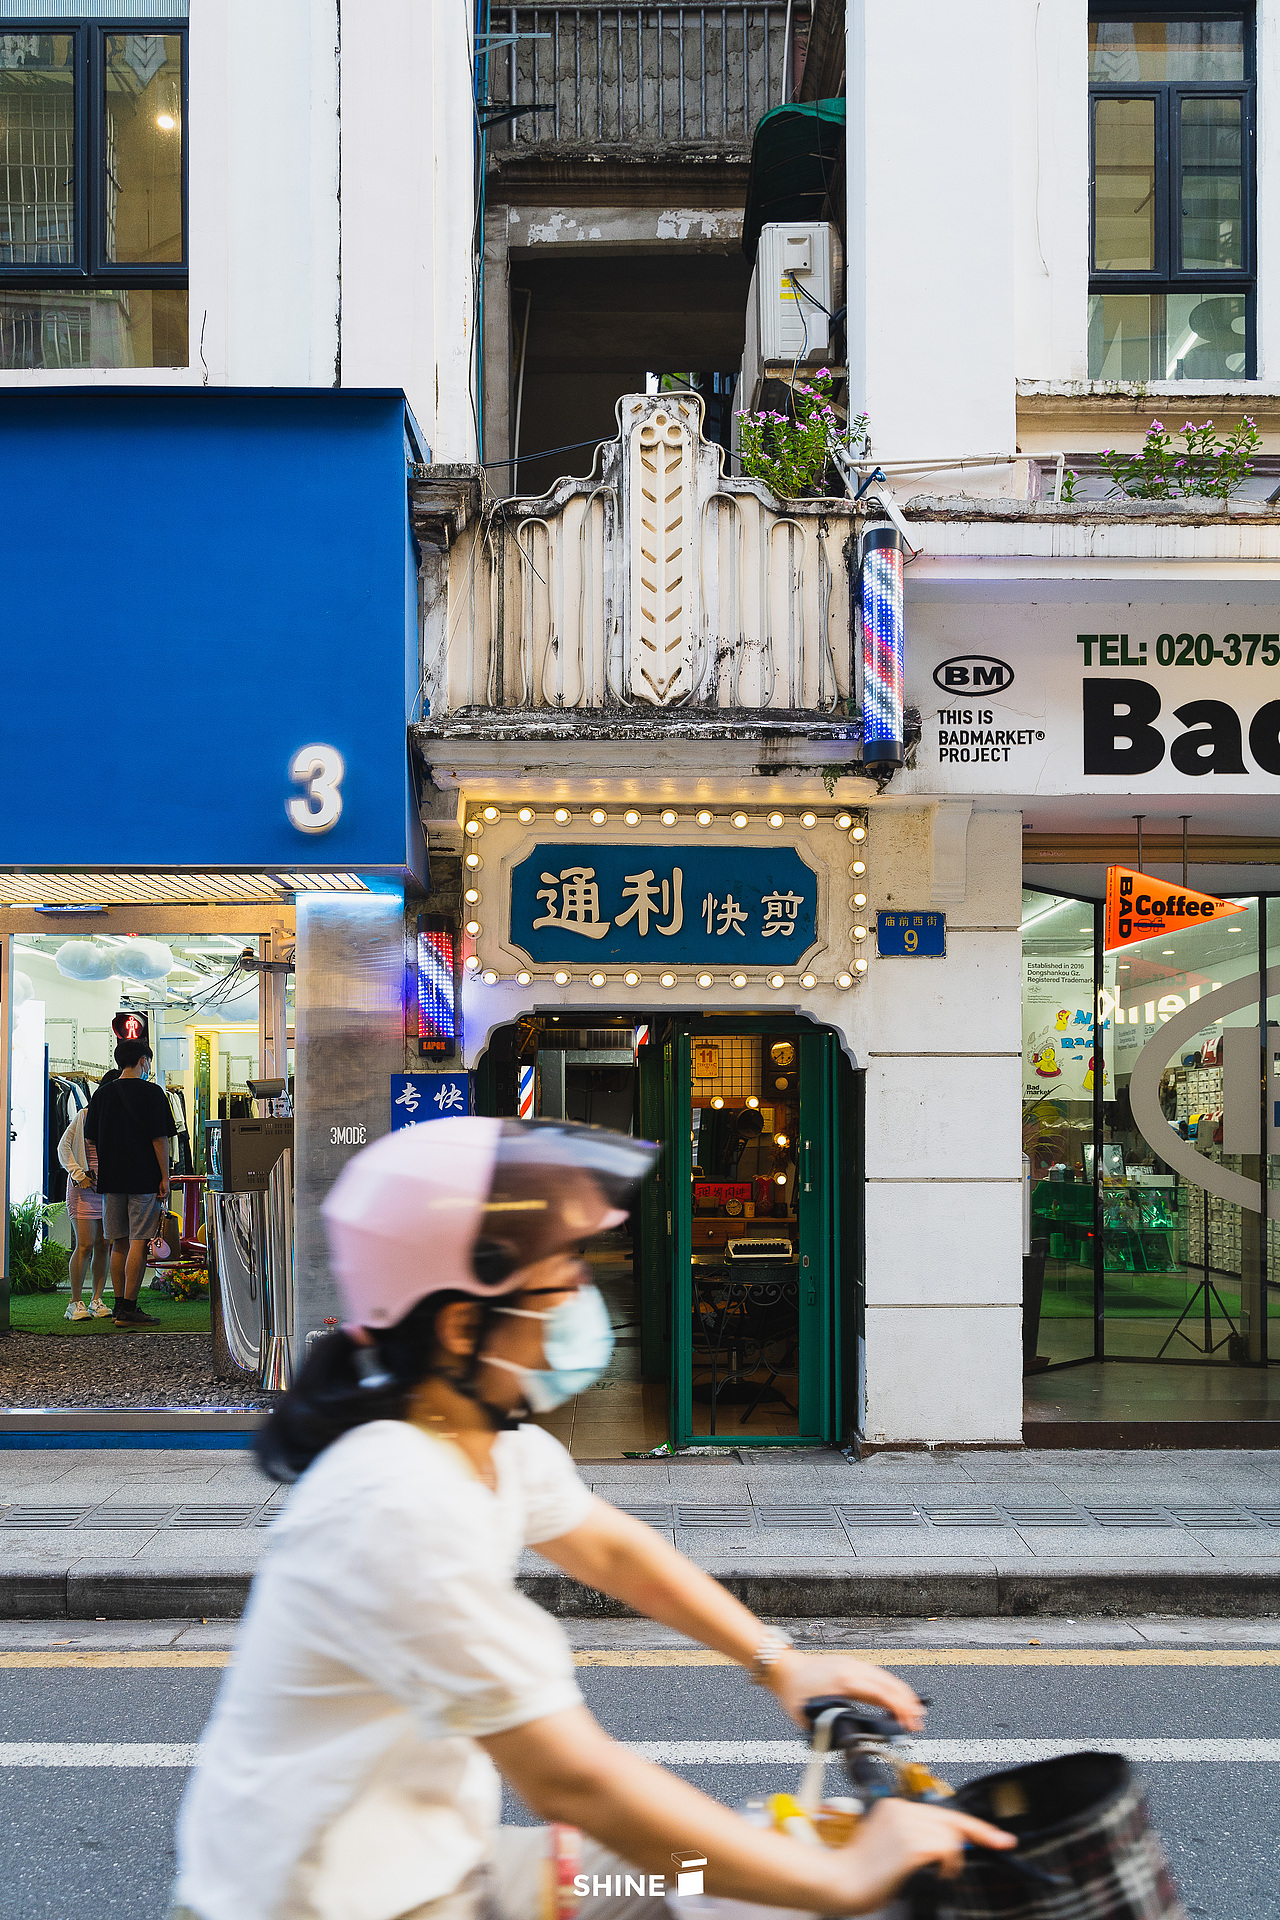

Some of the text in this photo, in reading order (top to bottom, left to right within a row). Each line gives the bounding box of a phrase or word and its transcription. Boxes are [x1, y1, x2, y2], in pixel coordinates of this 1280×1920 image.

[1076, 633, 1280, 666] TEL: 020-375
[944, 666, 1004, 686] BM
[937, 710, 994, 725] THIS IS
[939, 747, 1011, 762] PROJECT
[289, 745, 343, 831] 3
[532, 866, 805, 940] 通利 快剪
[1118, 876, 1133, 939] BAD
[884, 915, 937, 927] 庙前西街
[904, 929, 919, 952] 9
[1027, 969, 1070, 977] Dongshankou
[1027, 976, 1060, 984] Registered
